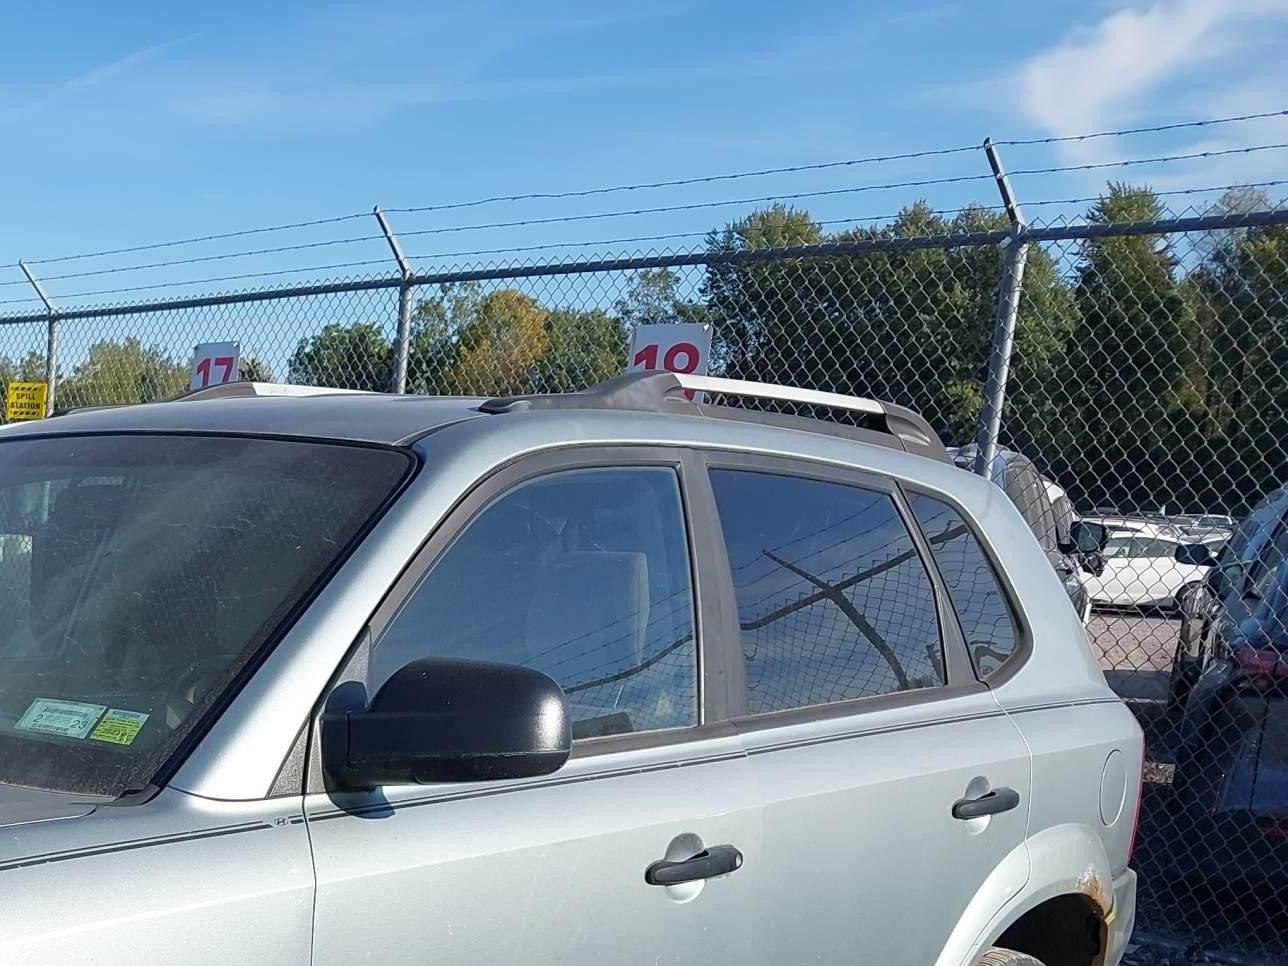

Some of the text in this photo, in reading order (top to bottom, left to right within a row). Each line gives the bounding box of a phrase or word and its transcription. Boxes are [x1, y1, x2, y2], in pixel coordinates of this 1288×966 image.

[196, 356, 234, 387] 17
[15, 392, 36, 400] SPILL
[33, 714, 44, 723] 2
[70, 719, 89, 730] 23
